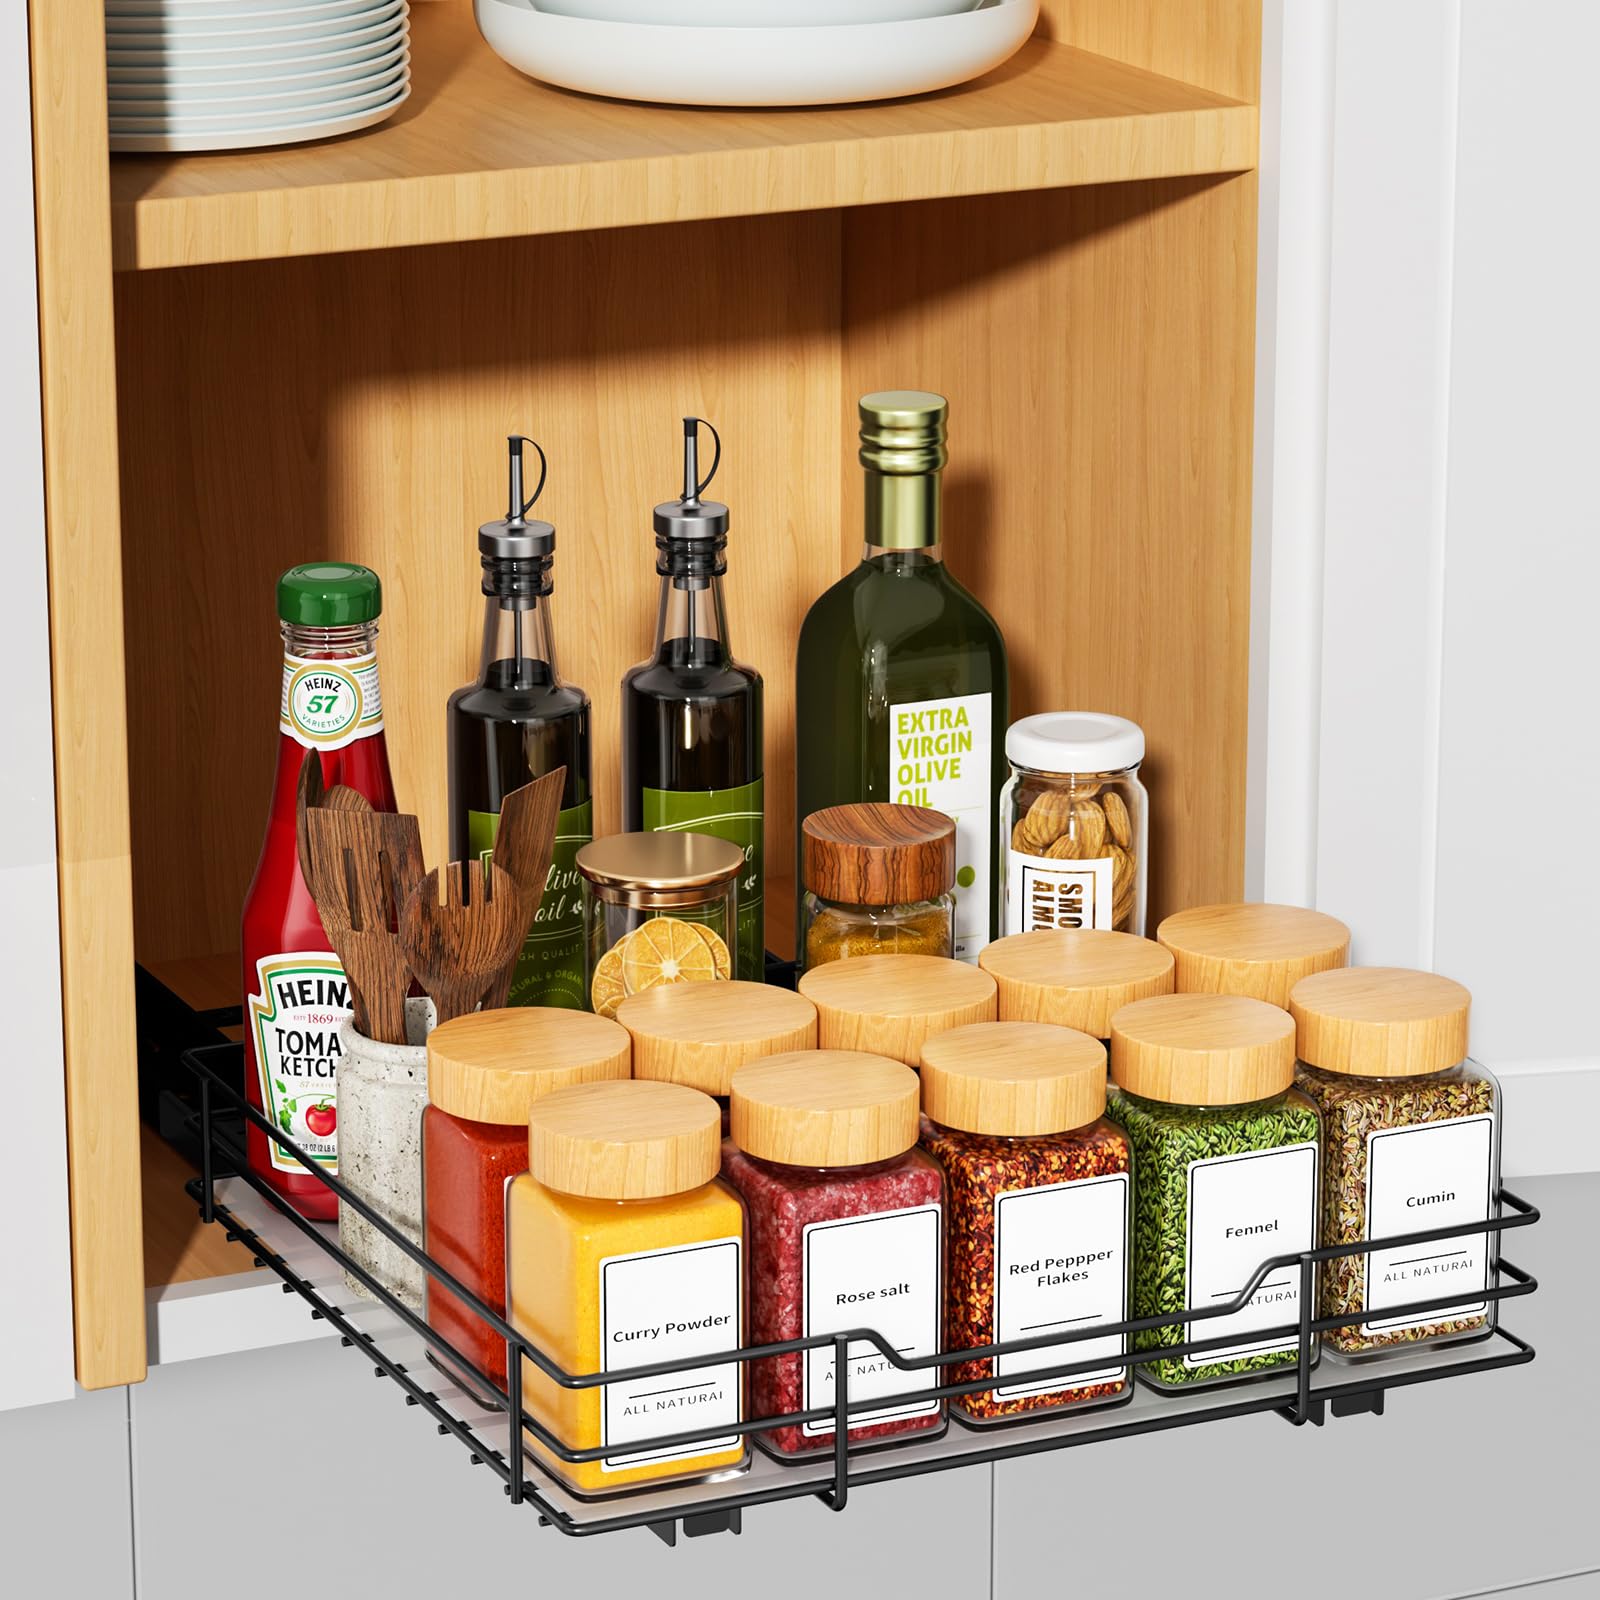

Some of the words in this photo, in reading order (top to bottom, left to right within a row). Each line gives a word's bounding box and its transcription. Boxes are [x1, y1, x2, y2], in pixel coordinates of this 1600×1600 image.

[304, 677, 342, 693] HEINZ
[306, 695, 339, 714] 57
[302, 713, 346, 729] VARIETIES
[897, 705, 969, 735] EXTRA
[897, 730, 972, 760] VIRGIN
[897, 757, 961, 786] OLIVE
[897, 787, 933, 808] OIL
[534, 894, 567, 923] oil
[307, 1013, 334, 1024] 1869
[275, 1027, 342, 1057] TOMA
[1406, 1190, 1455, 1208] Cumin
[1225, 1219, 1279, 1239] Fennel
[1009, 1260, 1040, 1276] Red
[1045, 1249, 1114, 1270] Peppper
[1037, 1270, 1089, 1288] Flakes
[1383, 1271, 1408, 1283] ALL
[836, 1290, 876, 1306] Rose
[879, 1282, 910, 1298] salt
[613, 1327, 661, 1343] Curry
[665, 1315, 731, 1335] Powder
[623, 1404, 650, 1417] ALL
